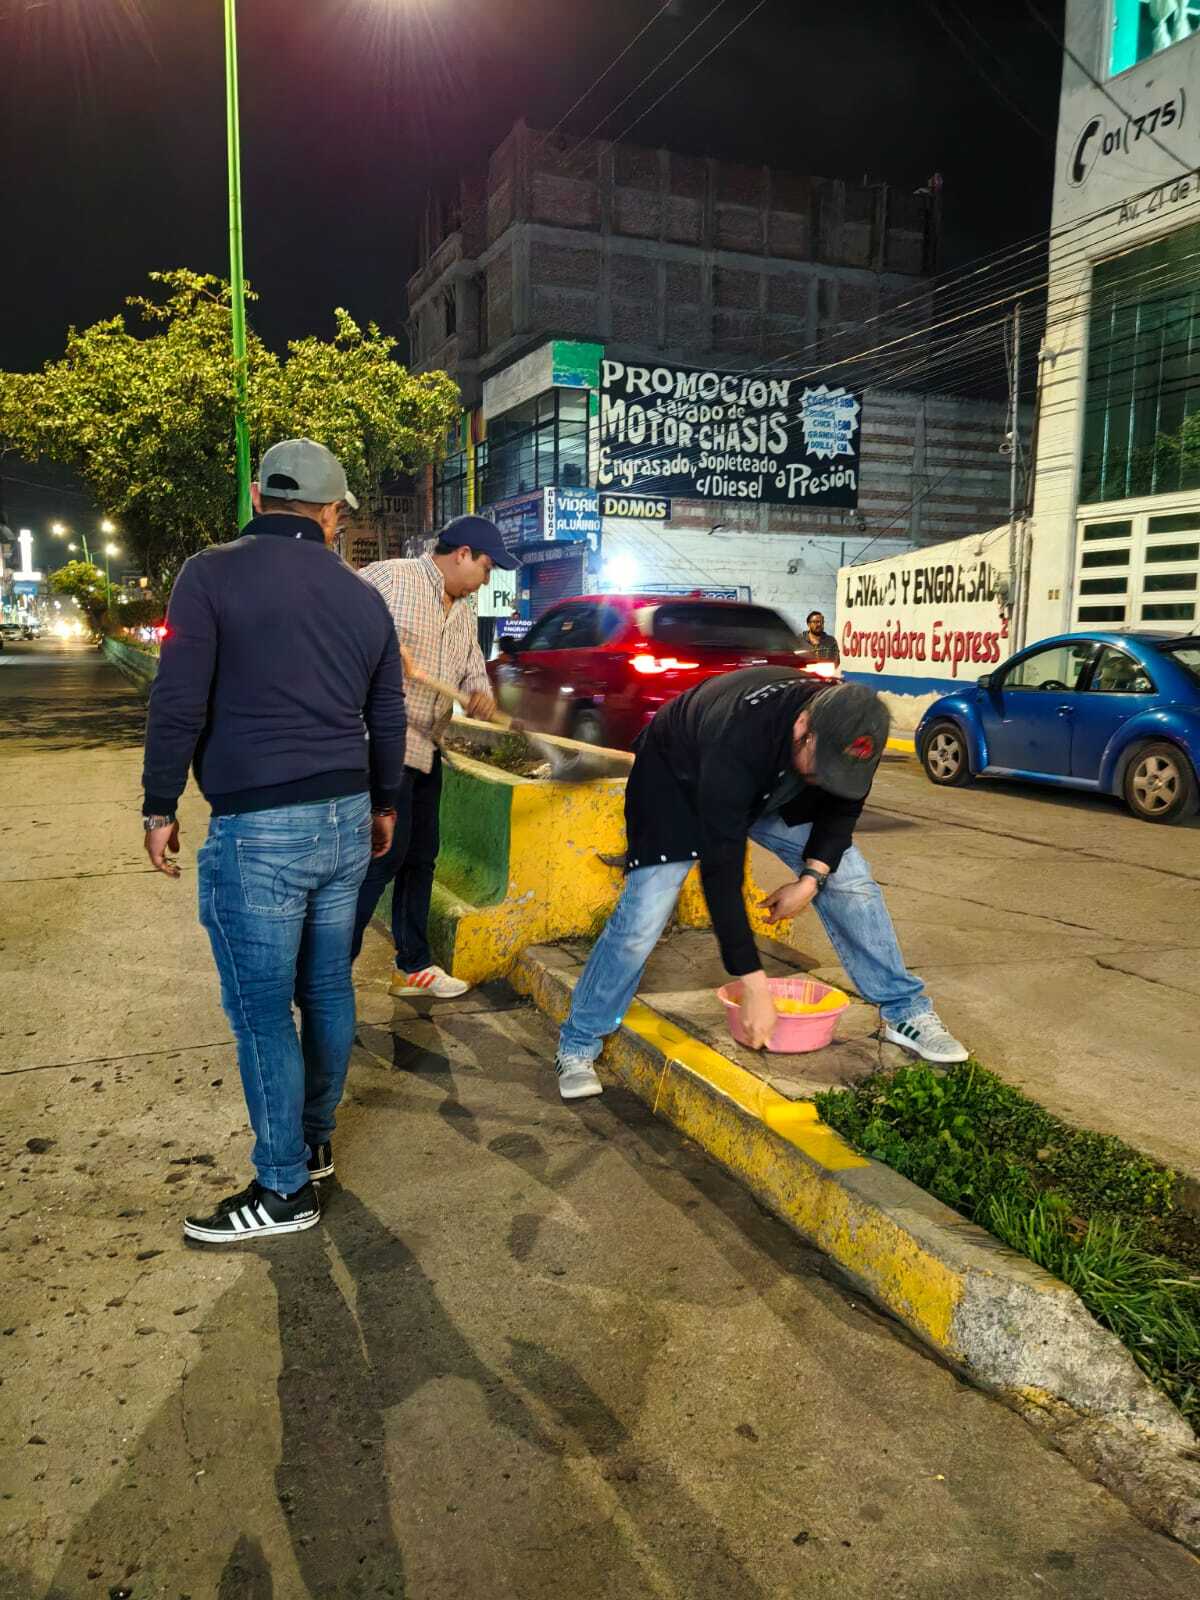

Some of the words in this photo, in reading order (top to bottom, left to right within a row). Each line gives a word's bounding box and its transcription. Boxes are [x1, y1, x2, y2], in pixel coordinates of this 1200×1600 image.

[1170, 182, 1190, 203] de
[602, 360, 791, 408] PROMOCION
[728, 405, 745, 419] de
[598, 446, 690, 487] Engrasado
[698, 451, 777, 473] Sopleteado
[696, 474, 763, 498] c/Diesel
[775, 469, 786, 488] a
[786, 463, 857, 499] Presión
[576, 511, 584, 520] Y
[605, 498, 667, 518] DOMOS
[901, 570, 911, 605] Y
[841, 619, 926, 672] Corregidora
